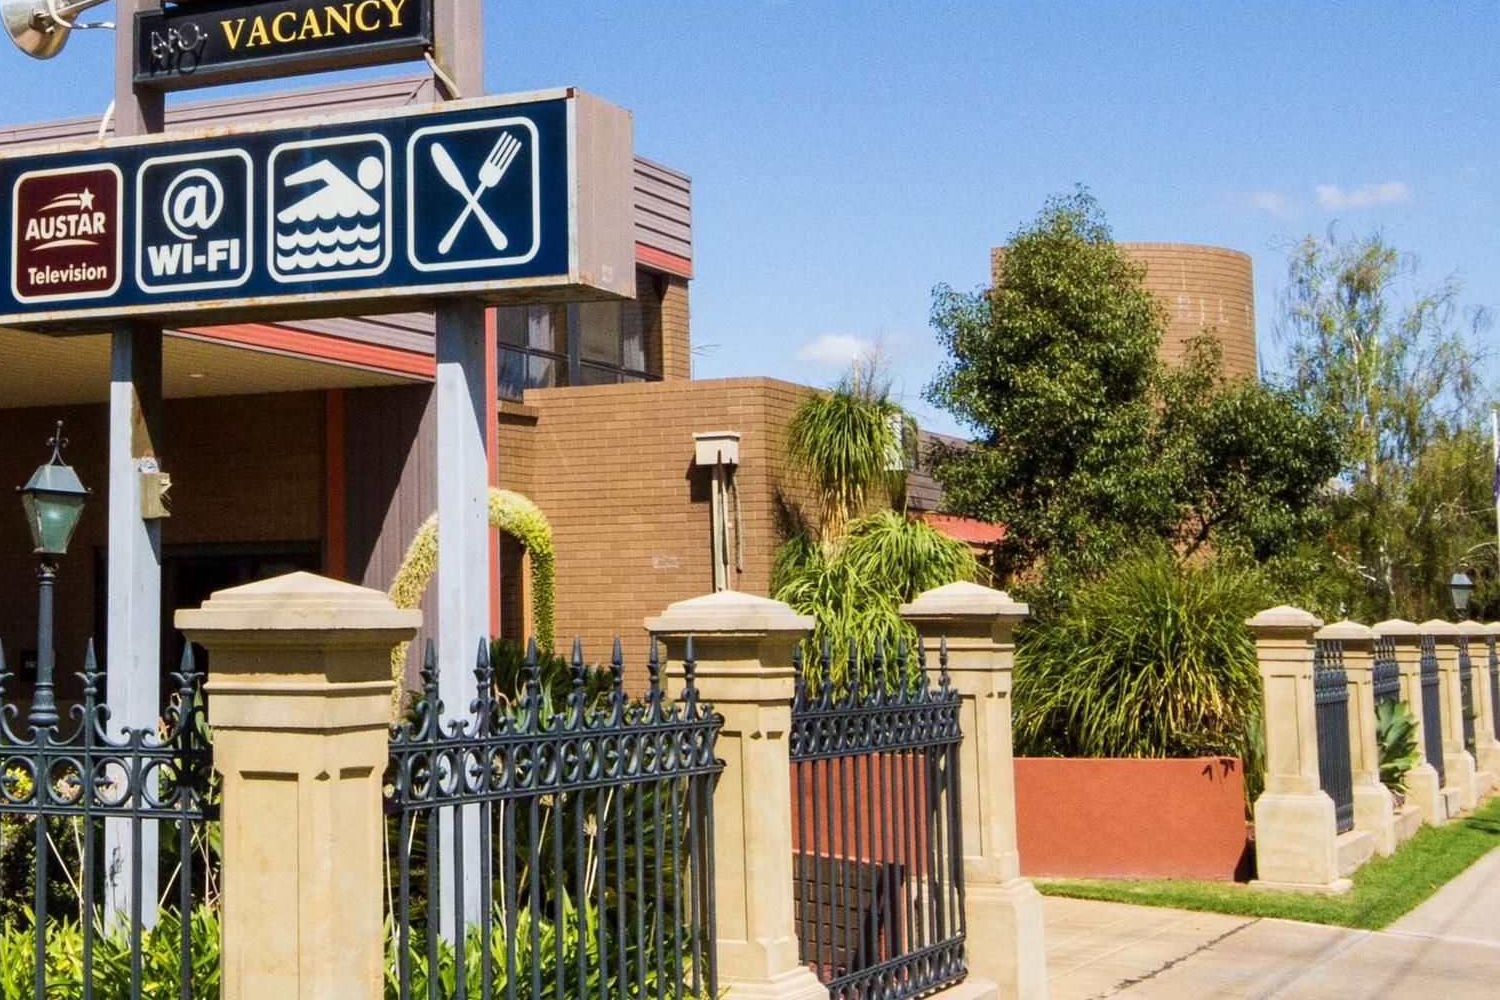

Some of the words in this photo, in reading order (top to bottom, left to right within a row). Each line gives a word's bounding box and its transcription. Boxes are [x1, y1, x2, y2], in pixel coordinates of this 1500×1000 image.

[24, 211, 106, 241] AUSTAR
[147, 238, 240, 277] WI-FI
[27, 262, 108, 286] Television
